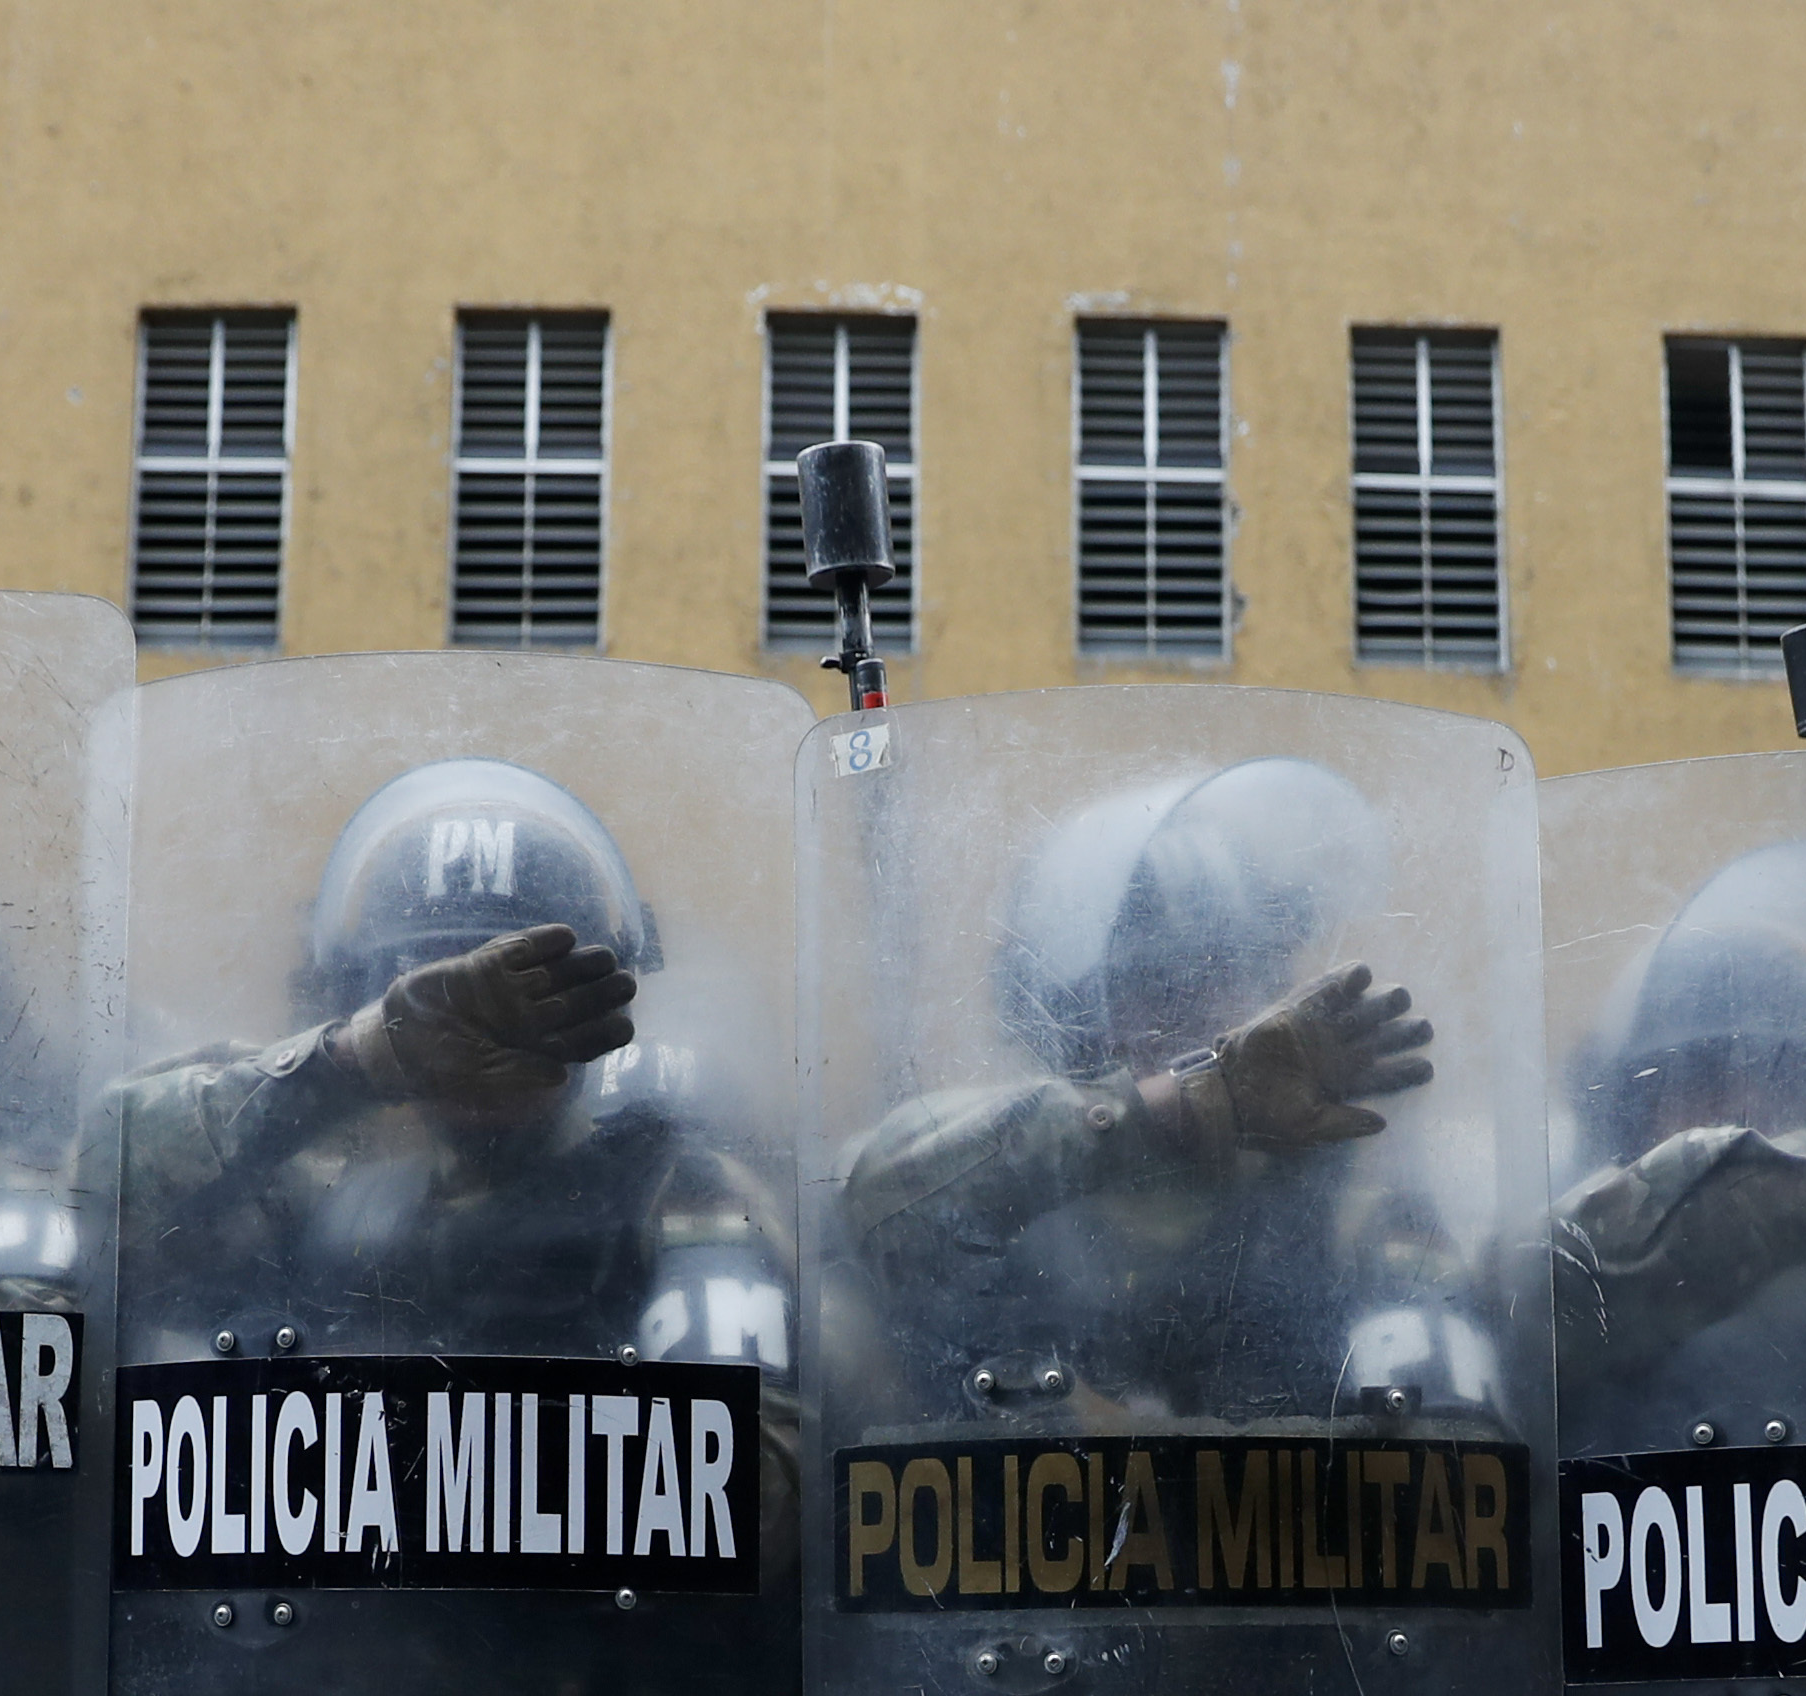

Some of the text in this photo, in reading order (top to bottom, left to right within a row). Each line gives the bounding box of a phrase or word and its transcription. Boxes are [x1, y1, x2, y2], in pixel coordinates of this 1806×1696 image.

[849, 730, 873, 771] 8
[427, 818, 516, 898] PM
[638, 1277, 788, 1369] PM
[130, 1391, 737, 1559] POLICIA MILITAR
[849, 1448, 1510, 1598] POLICIA MILITAR
